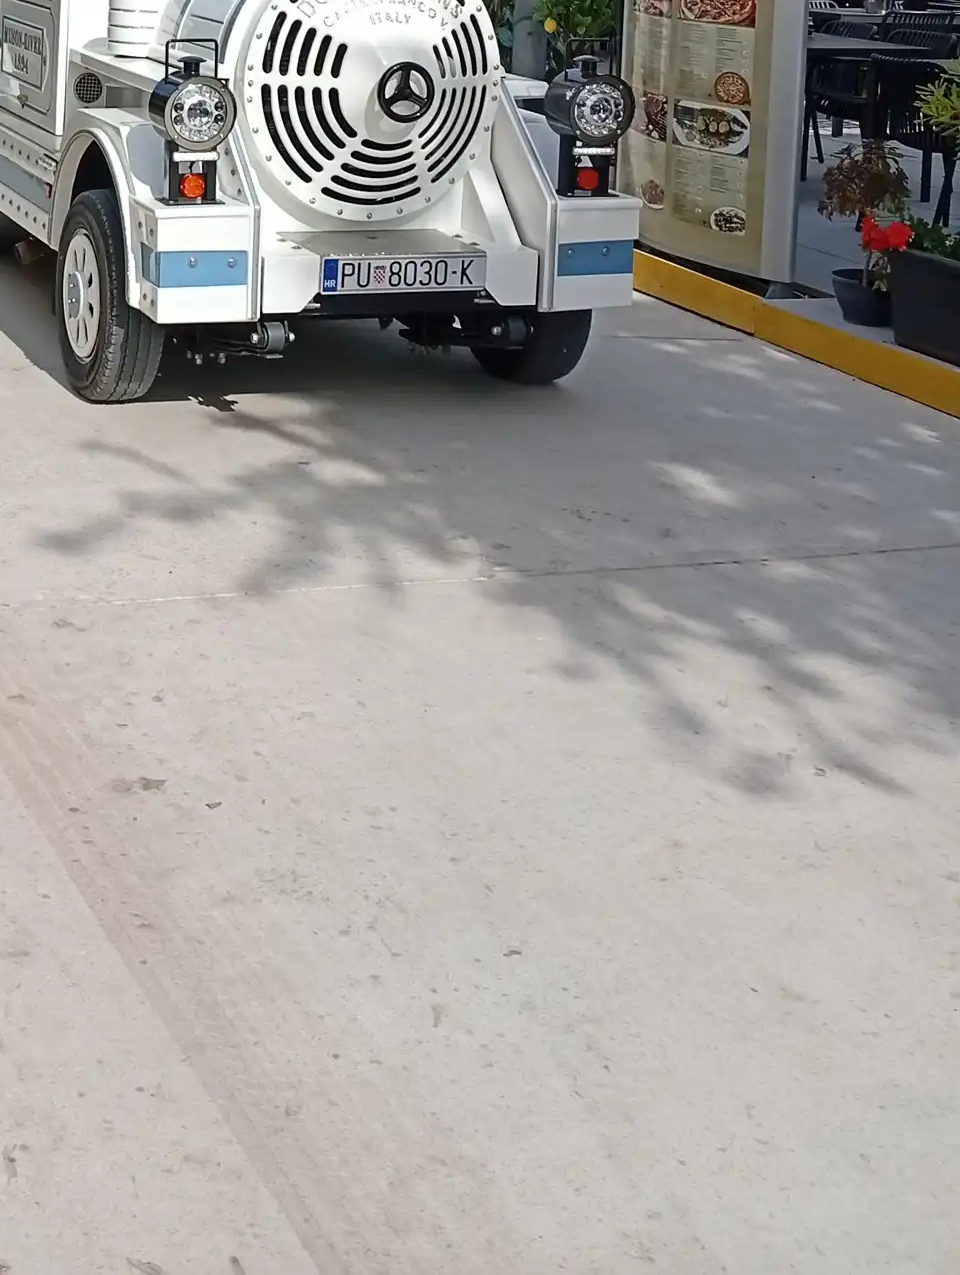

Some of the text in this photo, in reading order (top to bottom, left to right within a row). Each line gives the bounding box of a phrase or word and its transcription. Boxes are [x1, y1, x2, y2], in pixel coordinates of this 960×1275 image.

[368, 11, 411, 25] ITALY
[341, 259, 474, 289] PU 8030-K
[324, 279, 337, 288] HR
